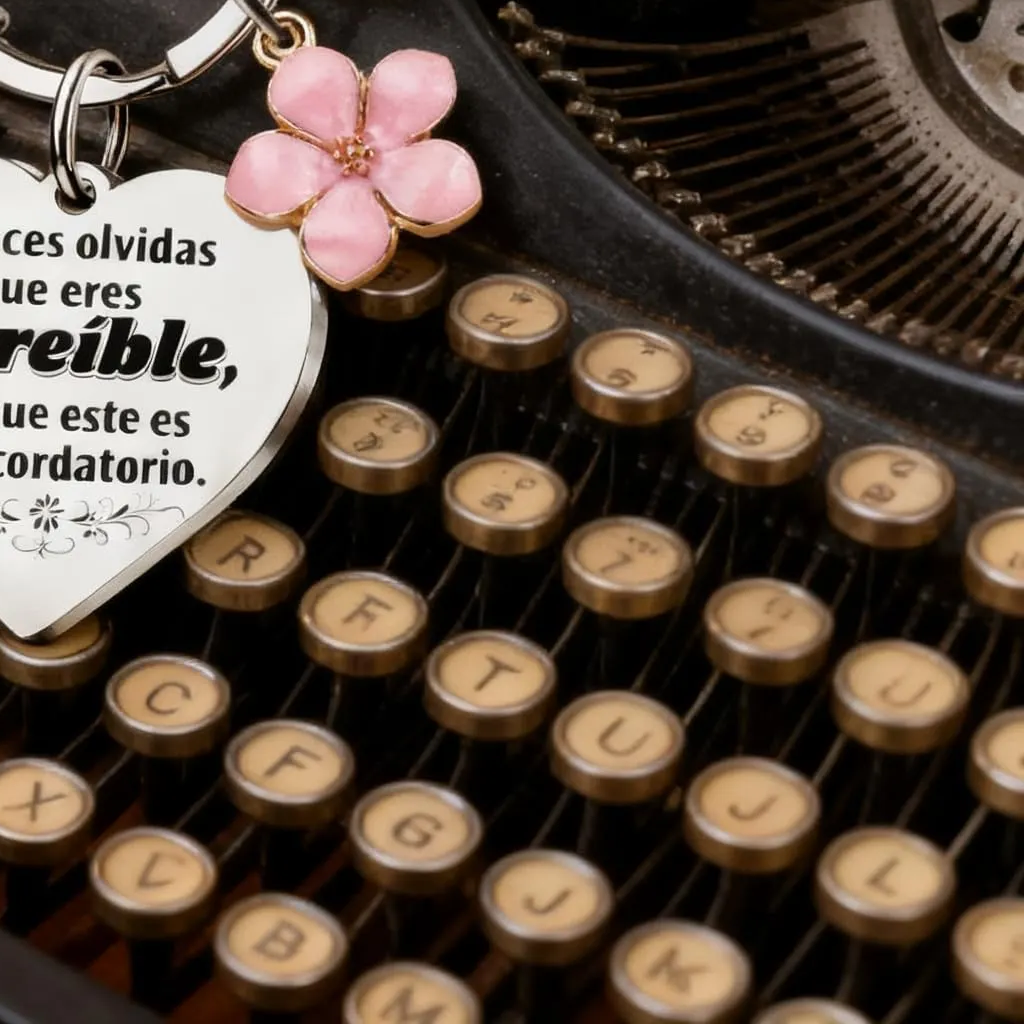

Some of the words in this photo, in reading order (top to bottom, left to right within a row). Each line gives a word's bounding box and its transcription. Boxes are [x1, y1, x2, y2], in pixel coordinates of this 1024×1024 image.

[77, 224, 216, 266] olvidas
[61, 281, 141, 309] eres
[61, 402, 139, 434] este
[150, 410, 189, 437] es
[216, 534, 264, 573] R
[473, 654, 521, 692] T
[146, 681, 191, 715] C
[597, 716, 651, 757] U
[264, 745, 322, 777] F
[2, 780, 67, 822] X
[728, 794, 778, 821] J
[392, 813, 443, 849] G
[523, 887, 572, 915] J
[251, 918, 306, 961] B
